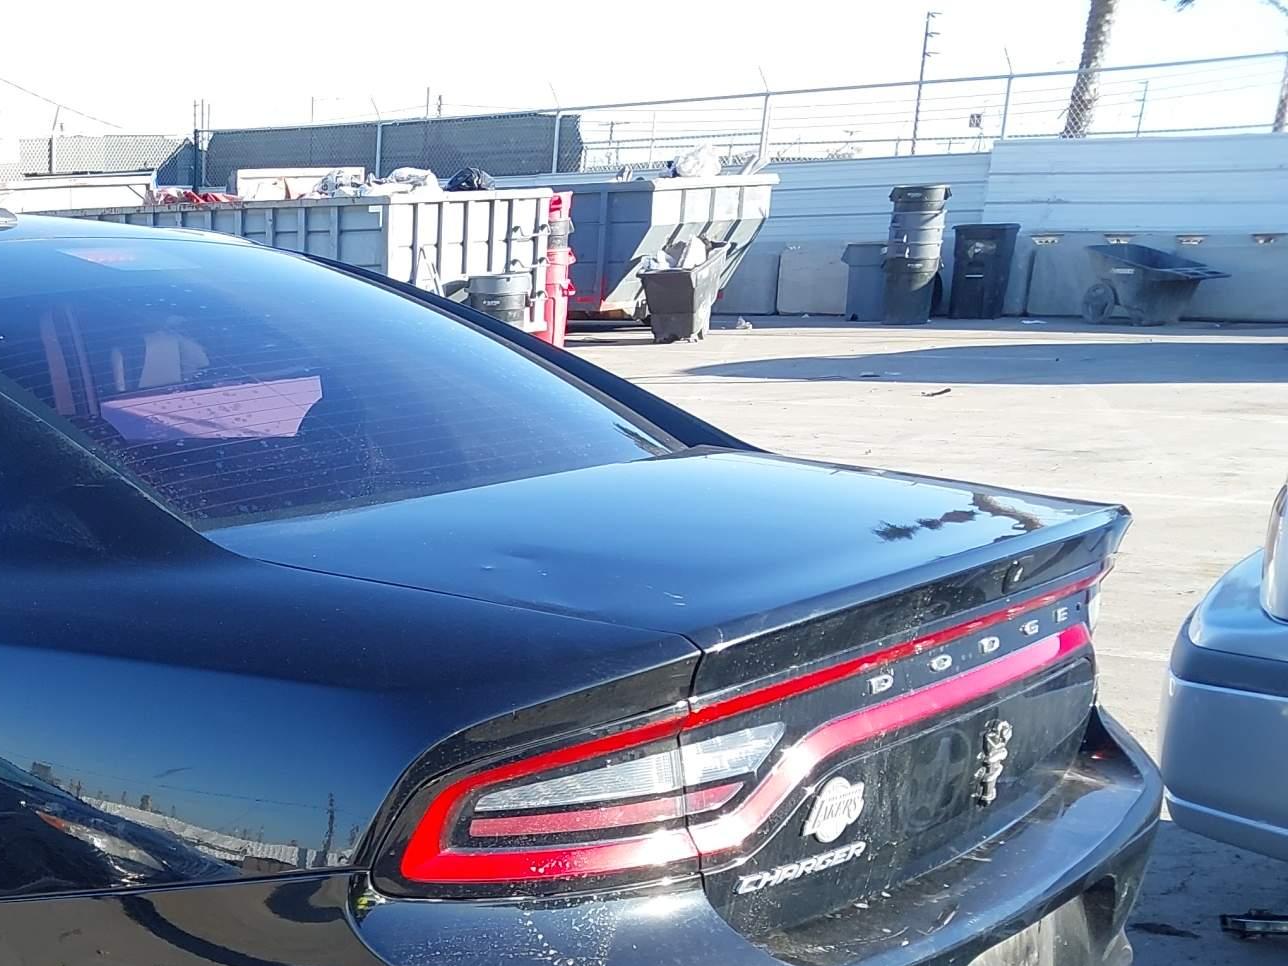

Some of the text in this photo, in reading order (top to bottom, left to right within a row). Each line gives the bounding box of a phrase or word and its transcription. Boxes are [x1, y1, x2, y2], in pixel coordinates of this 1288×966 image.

[868, 607, 1068, 695] DODGE
[811, 796, 861, 830] LAKERS
[733, 840, 867, 896] CHARGER
